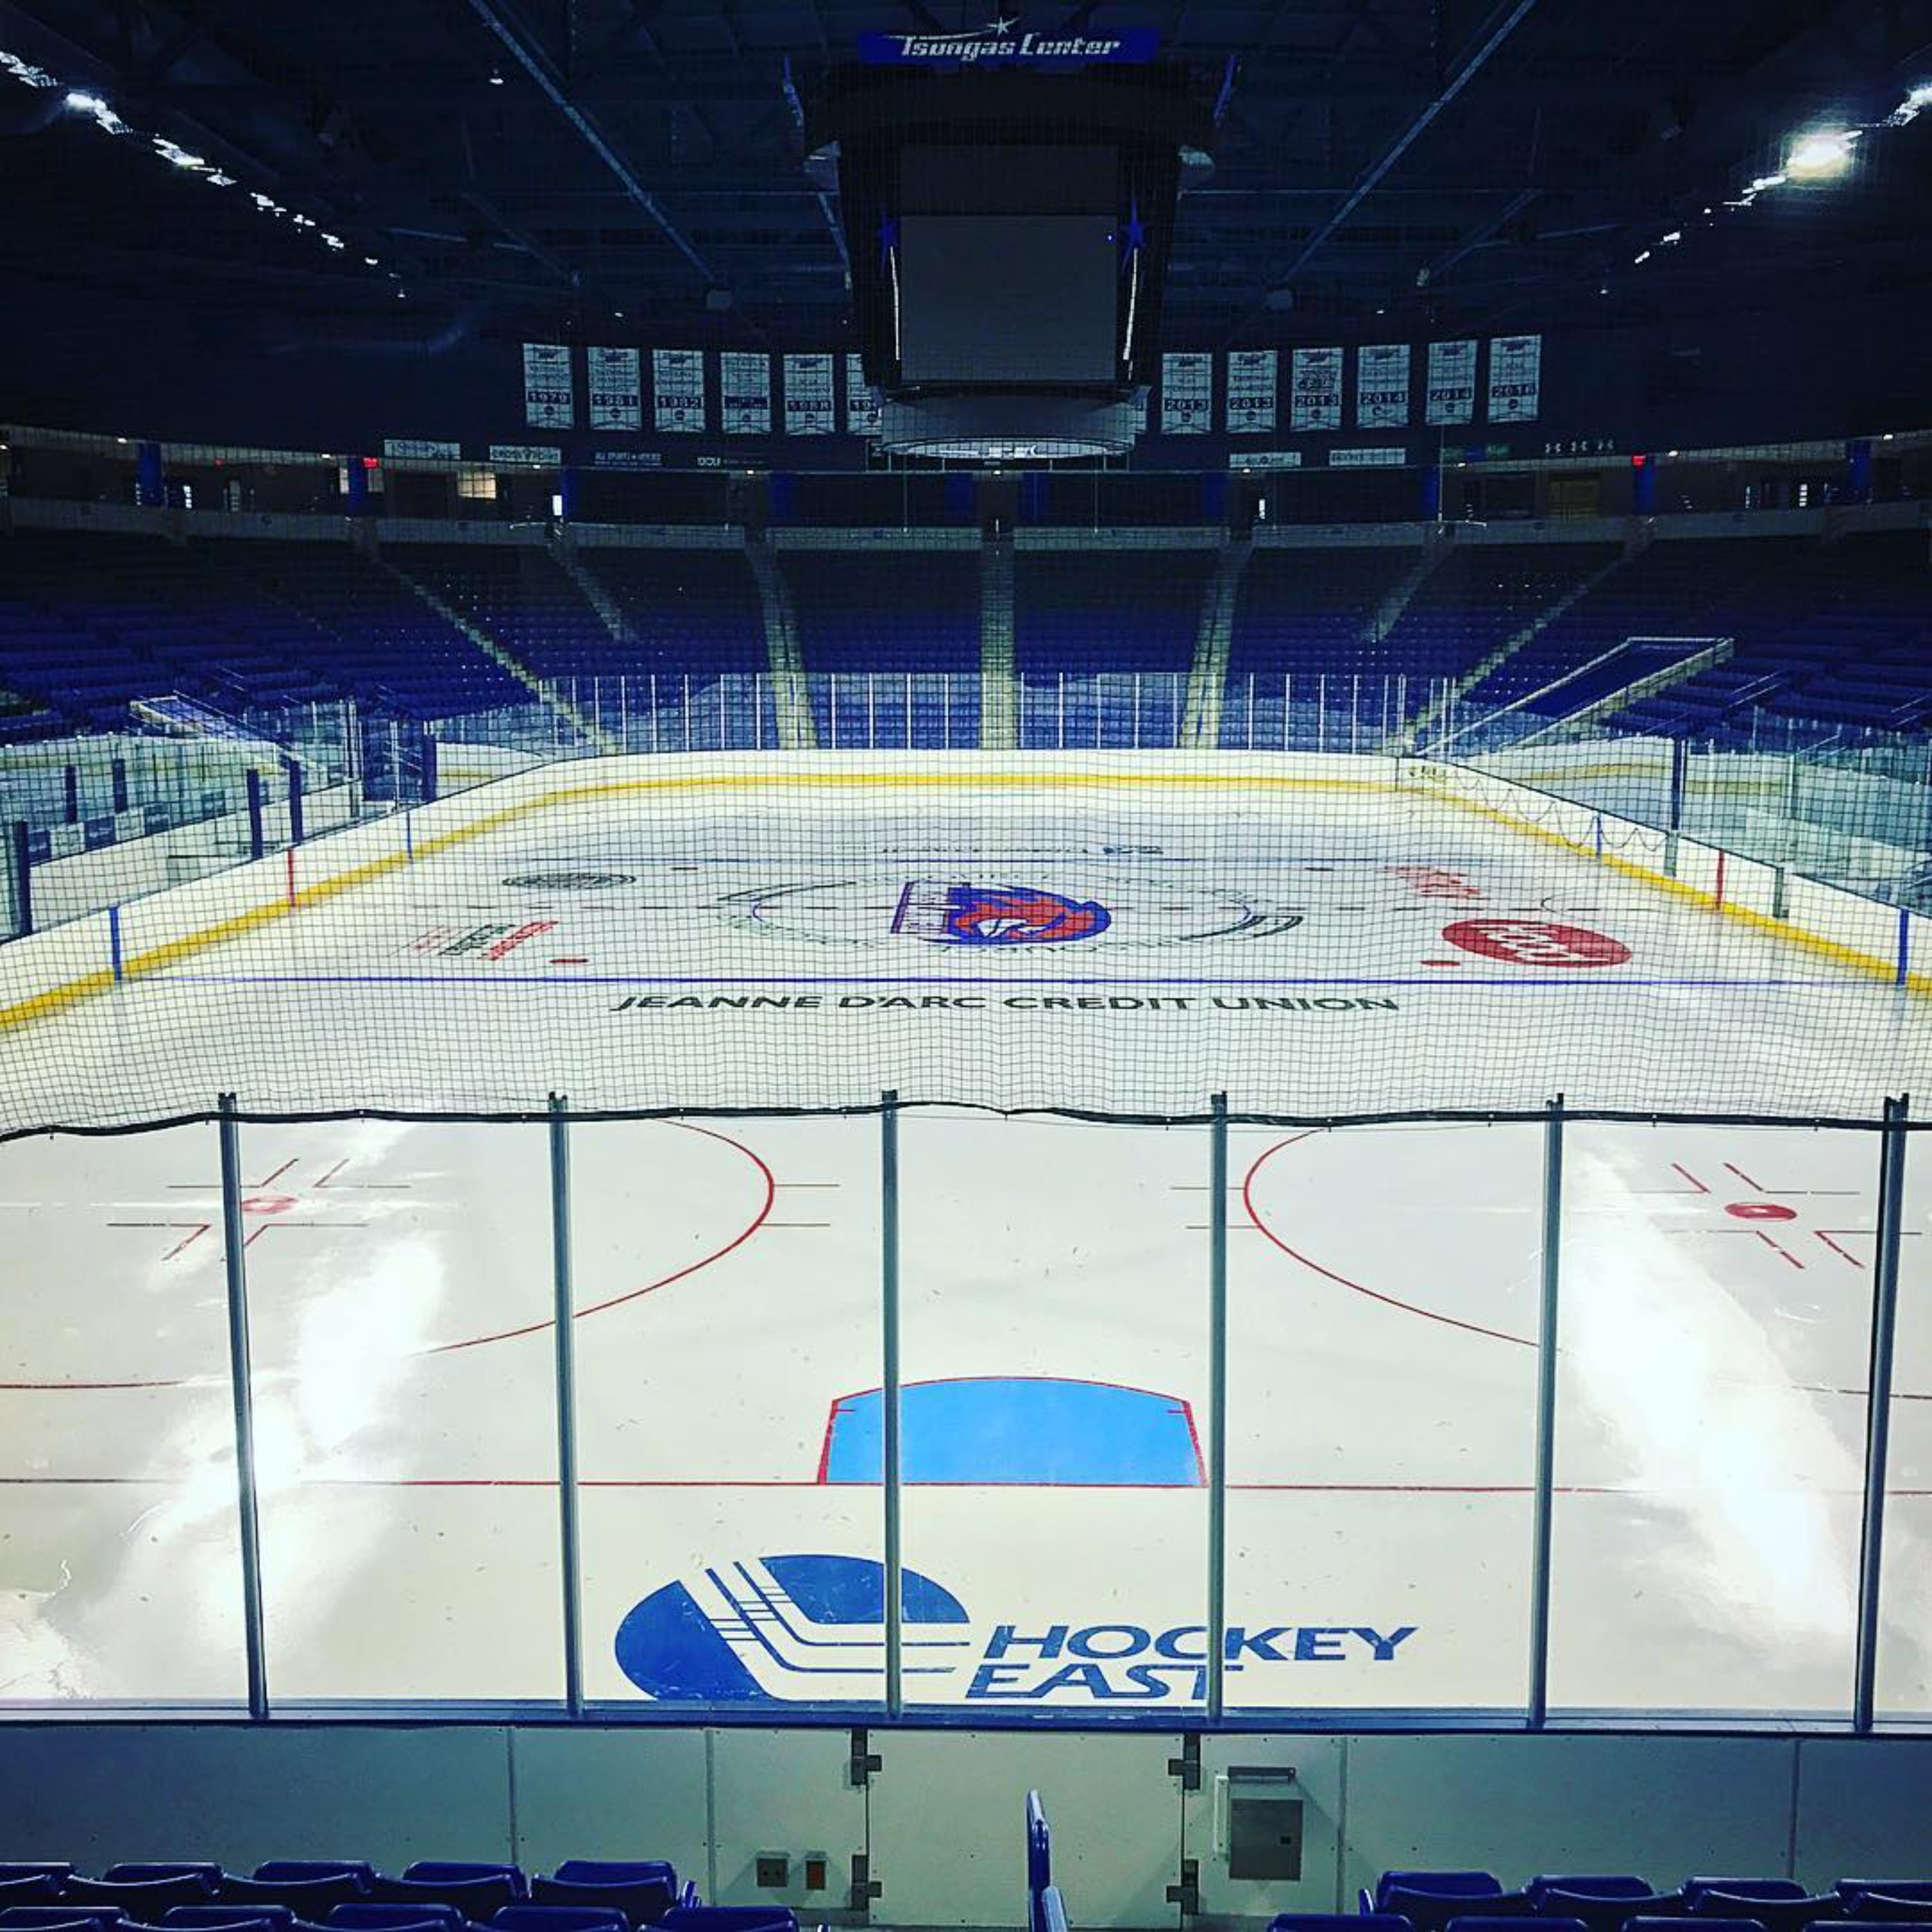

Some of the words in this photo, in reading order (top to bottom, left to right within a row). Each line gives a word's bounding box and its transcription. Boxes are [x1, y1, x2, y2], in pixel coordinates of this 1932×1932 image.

[1019, 32, 1121, 55] Center
[610, 996, 825, 1011] JEANNE
[838, 996, 987, 1009] D'ARC
[1004, 997, 1196, 1010] CREDIT
[1211, 997, 1400, 1010] UNION
[982, 1625, 1419, 1661] HOCKEY
[965, 1663, 1244, 1701] EAST
